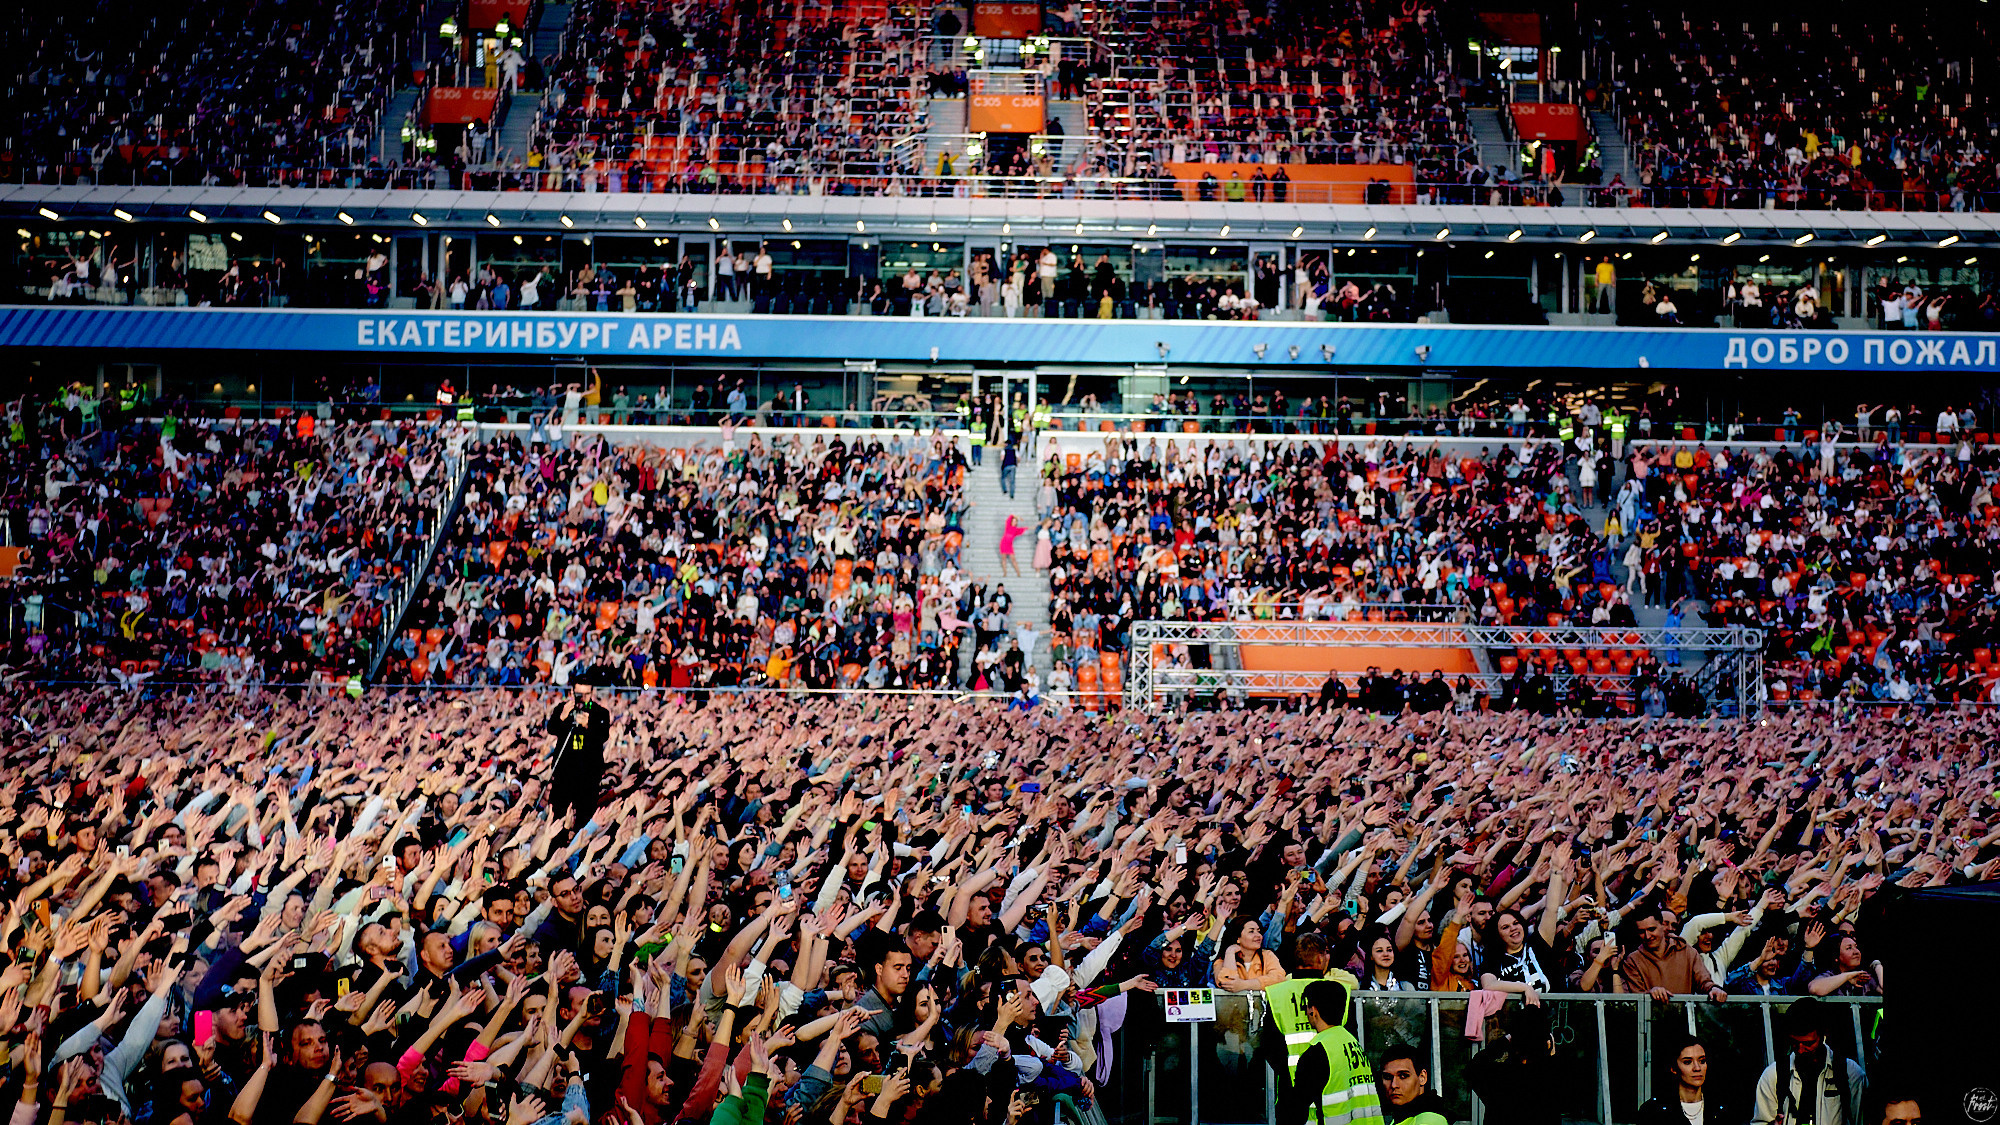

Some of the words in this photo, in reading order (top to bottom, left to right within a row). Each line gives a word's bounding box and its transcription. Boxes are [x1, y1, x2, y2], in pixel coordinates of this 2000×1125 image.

[357, 319, 619, 349] ЕКАТЕРИНБУРГ
[628, 323, 742, 350] АРЕНА
[1723, 337, 1849, 369] ДОБРО
[1863, 339, 1996, 366] ПОЖАЛ
